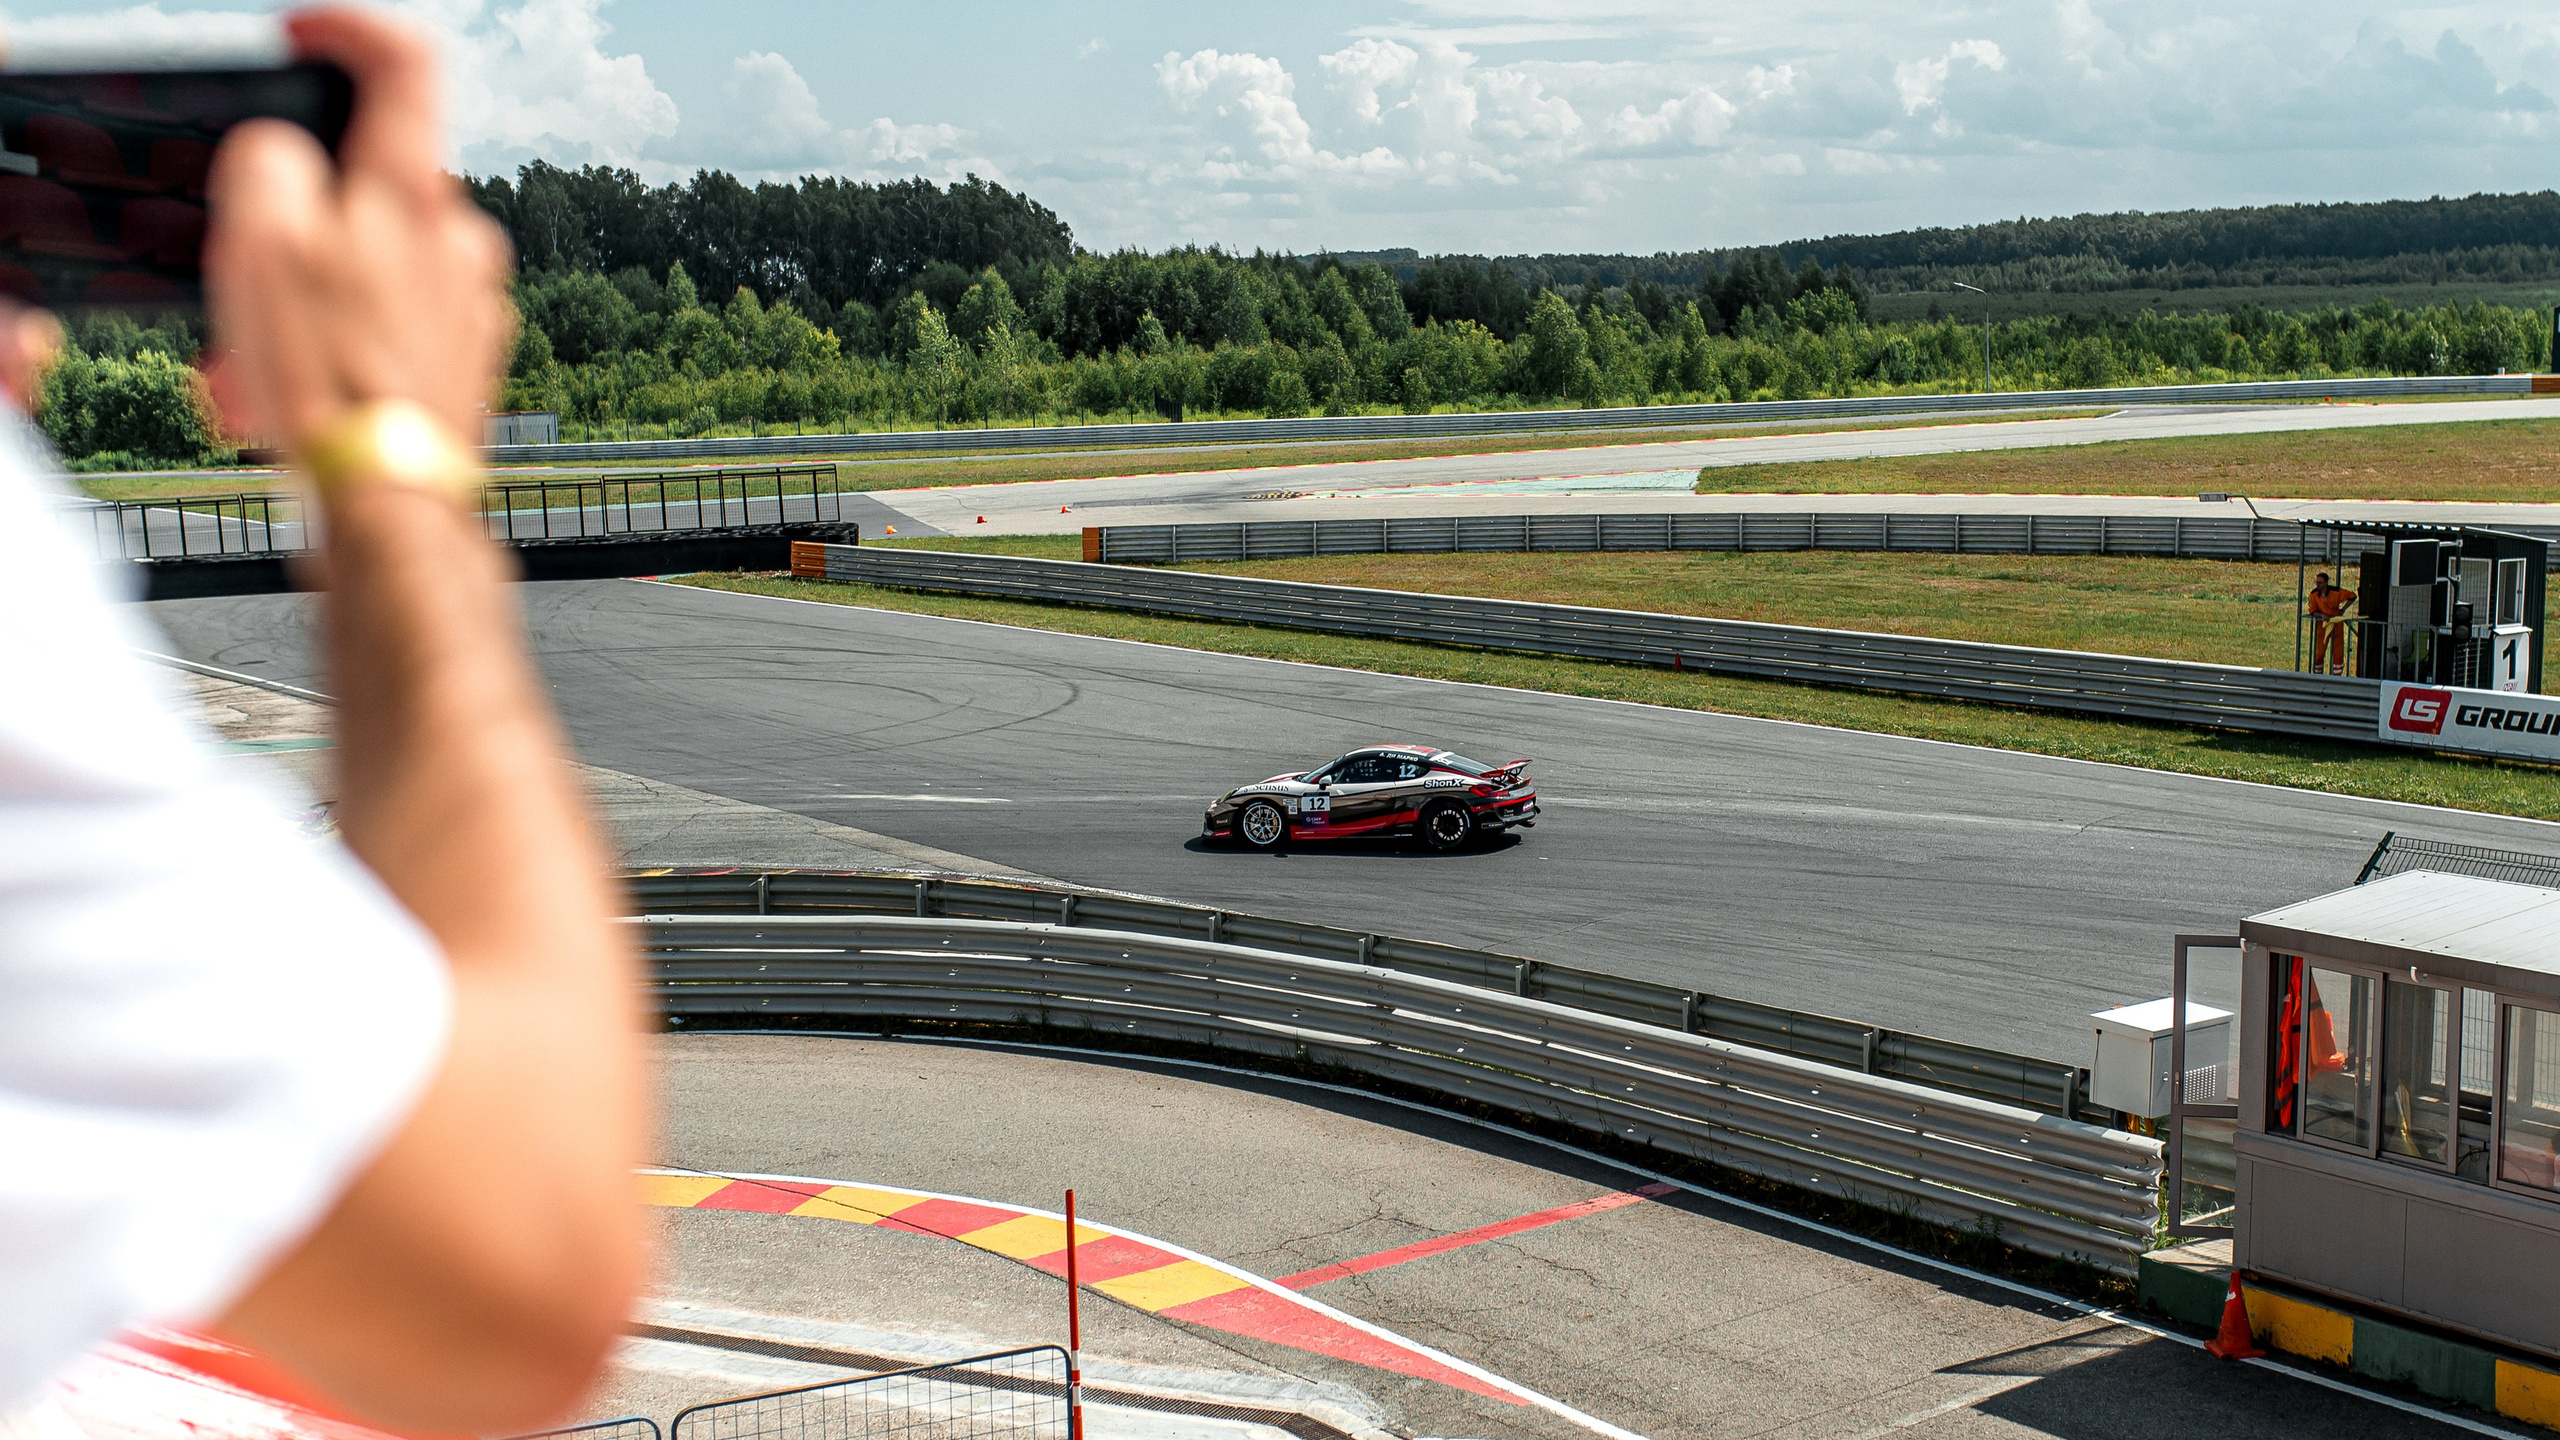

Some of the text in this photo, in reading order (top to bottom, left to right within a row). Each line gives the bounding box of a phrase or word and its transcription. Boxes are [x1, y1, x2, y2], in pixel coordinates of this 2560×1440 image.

[2503, 639, 2516, 680] 1
[2400, 698, 2440, 722] LS
[1399, 763, 1416, 778] 12
[1309, 797, 1325, 810] 12
